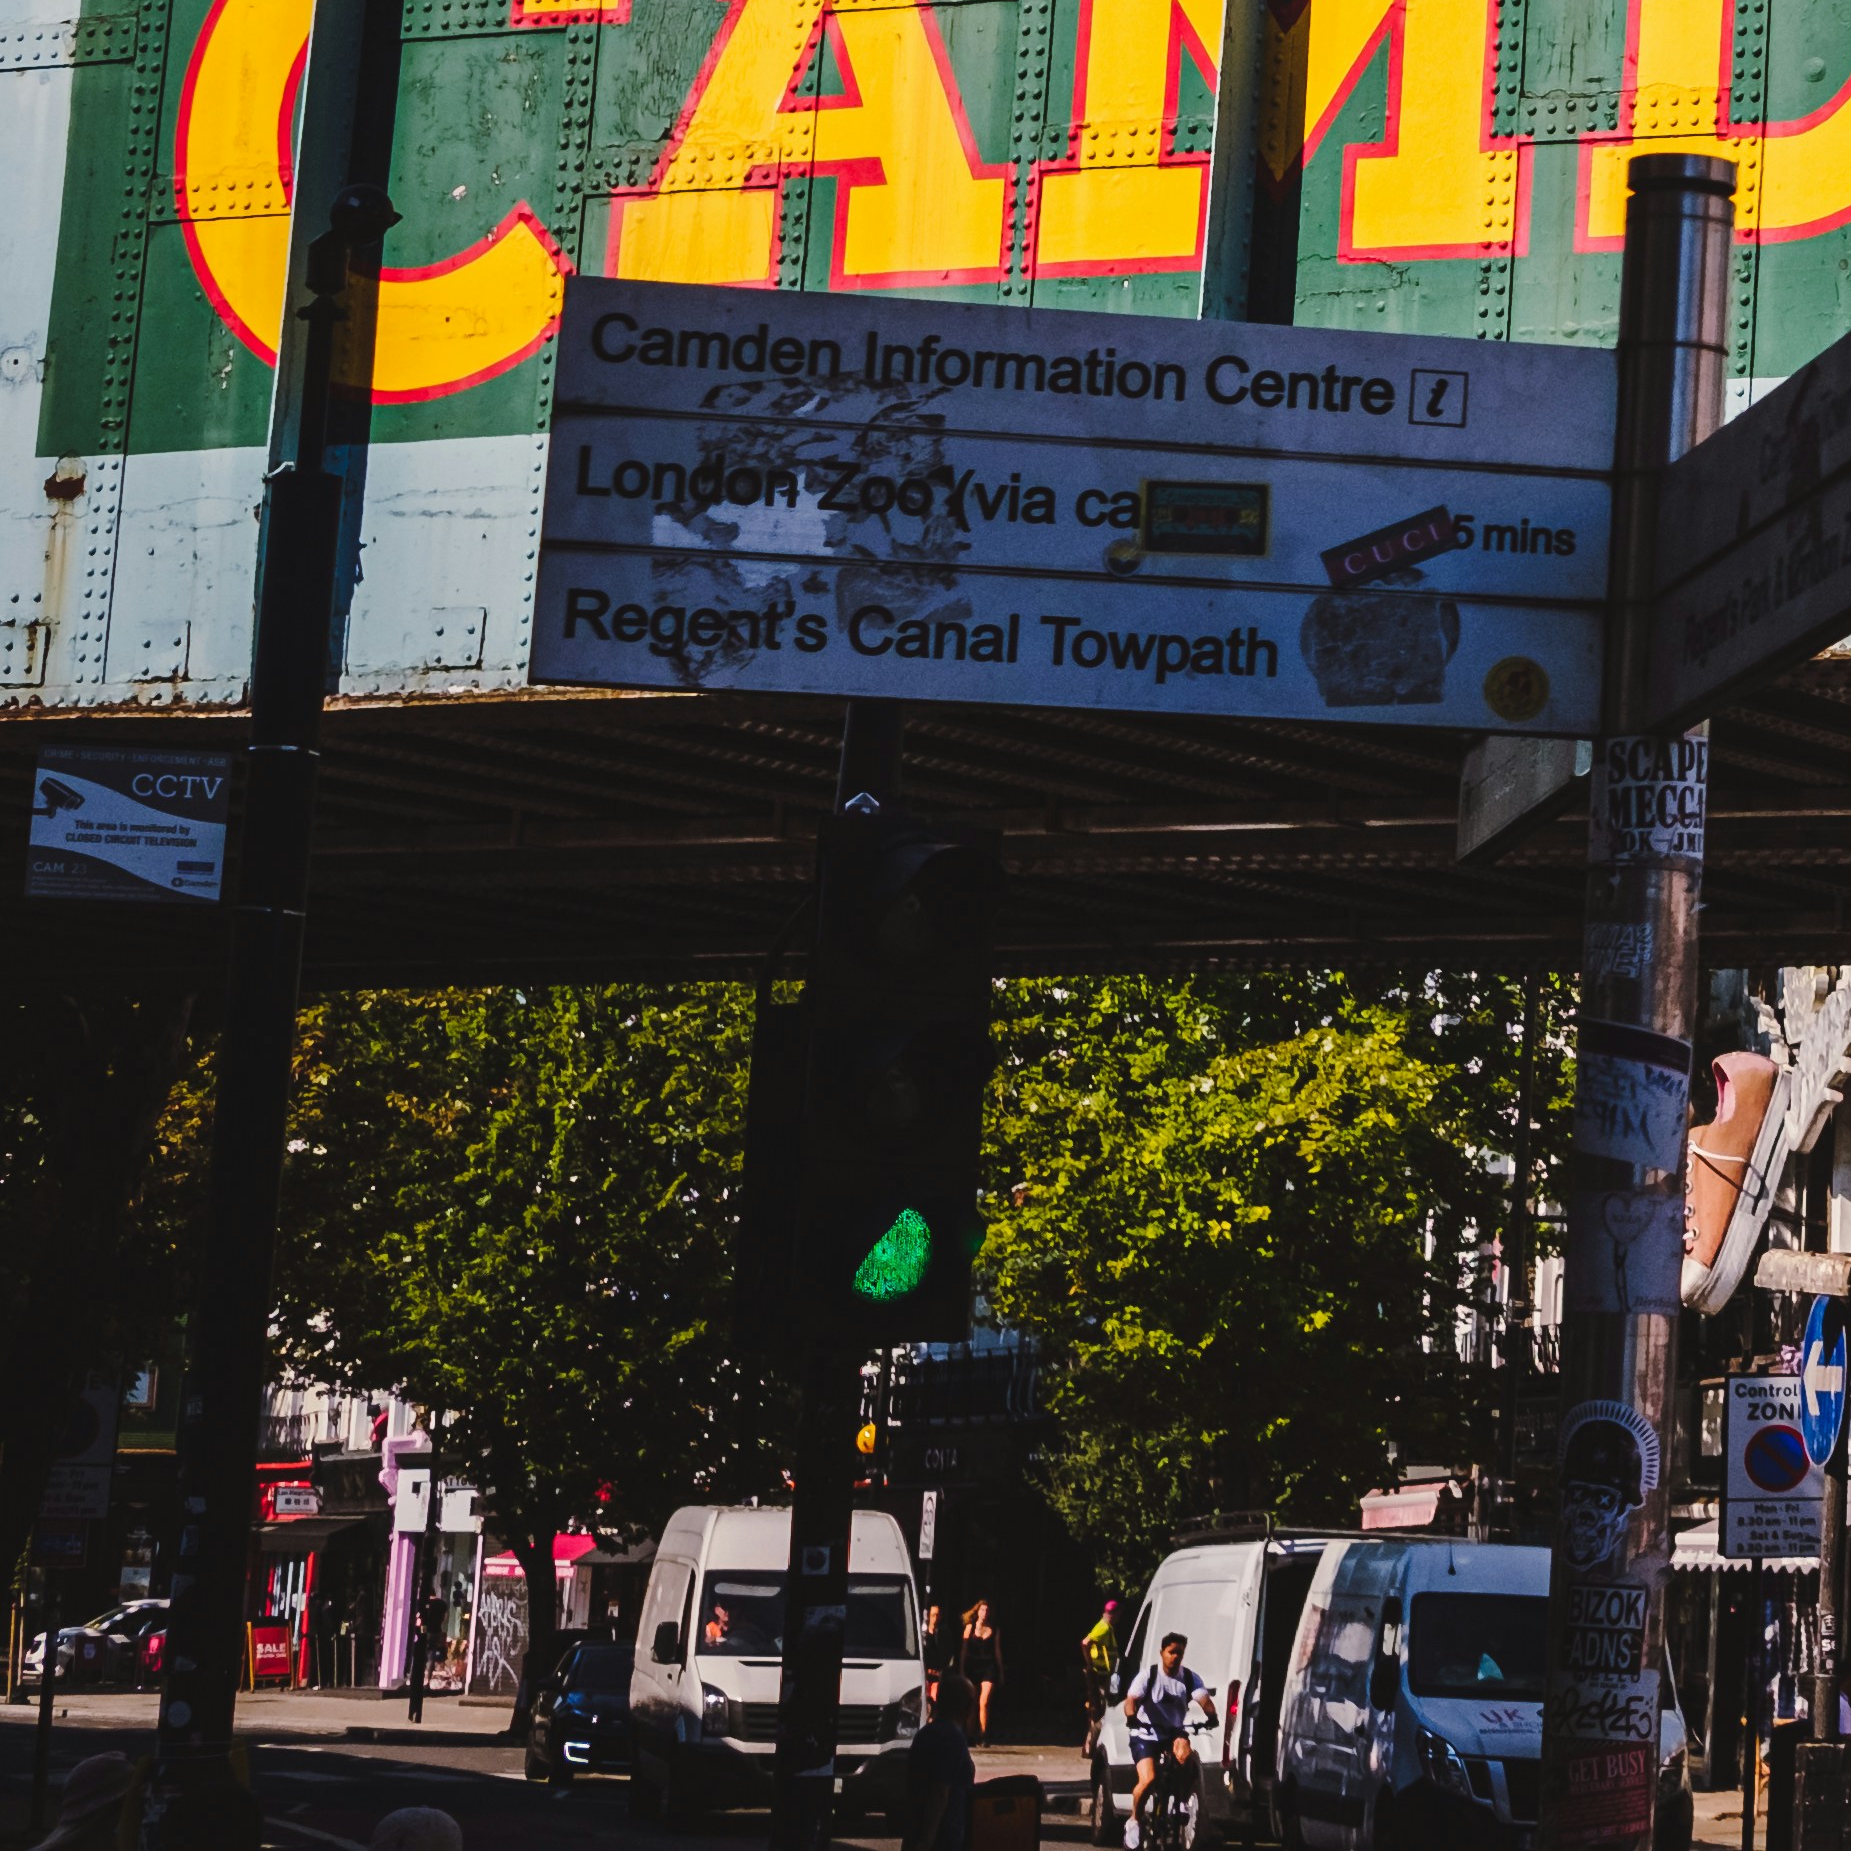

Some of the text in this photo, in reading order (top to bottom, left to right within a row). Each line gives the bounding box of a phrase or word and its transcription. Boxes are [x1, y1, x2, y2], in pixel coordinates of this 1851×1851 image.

[591, 312, 841, 377] Camden
[864, 330, 1187, 403] Information
[1205, 354, 1395, 416] Centre
[575, 445, 799, 509] London
[817, 462, 934, 516] Zoo
[948, 468, 1056, 533] (via
[1482, 518, 1577, 556] mins
[563, 588, 1279, 685] Regent's Canal Towpath
[80, 751, 125, 762] SECURITY
[131, 773, 224, 800] CCTV
[74, 819, 191, 836] This area is monitored by
[66, 833, 198, 848] CLOSED CIRCUIT TELEVISION
[33, 861, 65, 873] CAM
[1735, 1383, 1800, 1399] Control
[1747, 1402, 1800, 1421] ZON
[1754, 1503, 1800, 1514] Mon Fri
[1750, 1529, 1769, 1541] Sat
[1569, 1588, 1643, 1627] BIZOK
[256, 1642, 286, 1652] SALE
[1568, 1748, 1647, 1783] GET BUSY
